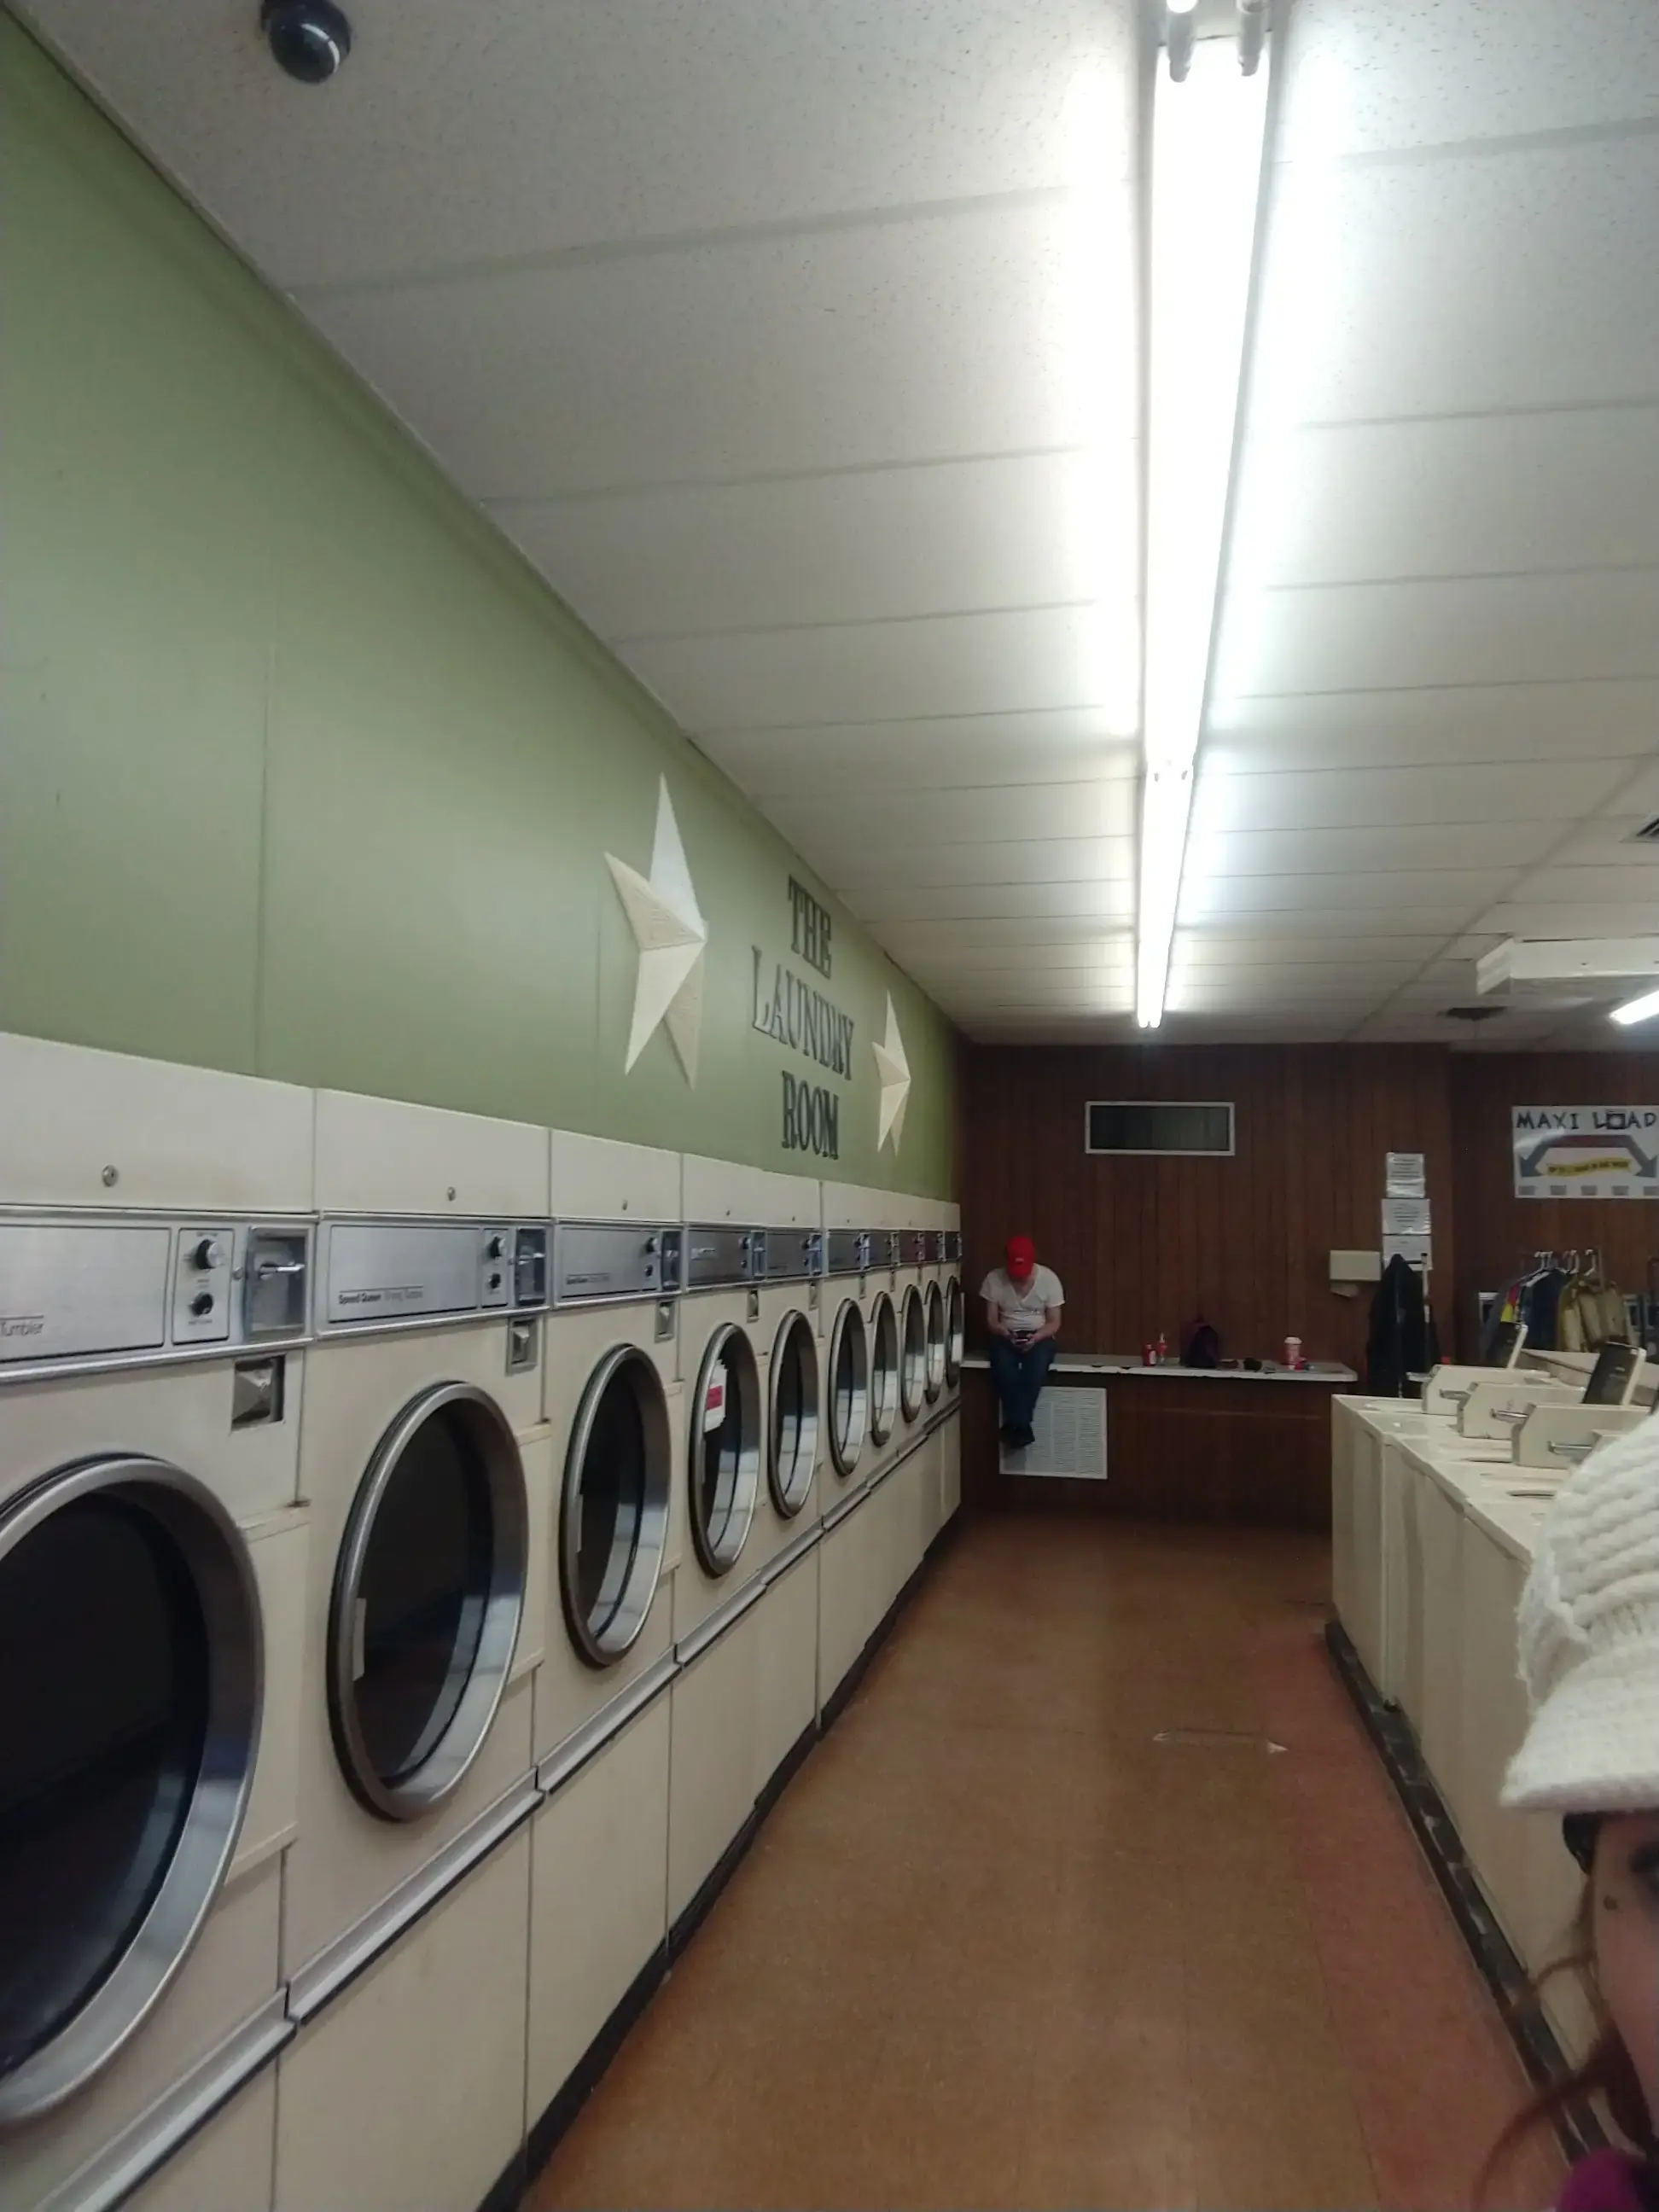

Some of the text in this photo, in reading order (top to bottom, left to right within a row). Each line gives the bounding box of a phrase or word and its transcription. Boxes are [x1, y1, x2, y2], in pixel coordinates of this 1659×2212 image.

[789, 874, 831, 979] THE
[752, 945, 854, 1080] LAUNDRY
[782, 1070, 839, 1160] ROOM
[1516, 1110, 1657, 1130] MAXI LOAD
